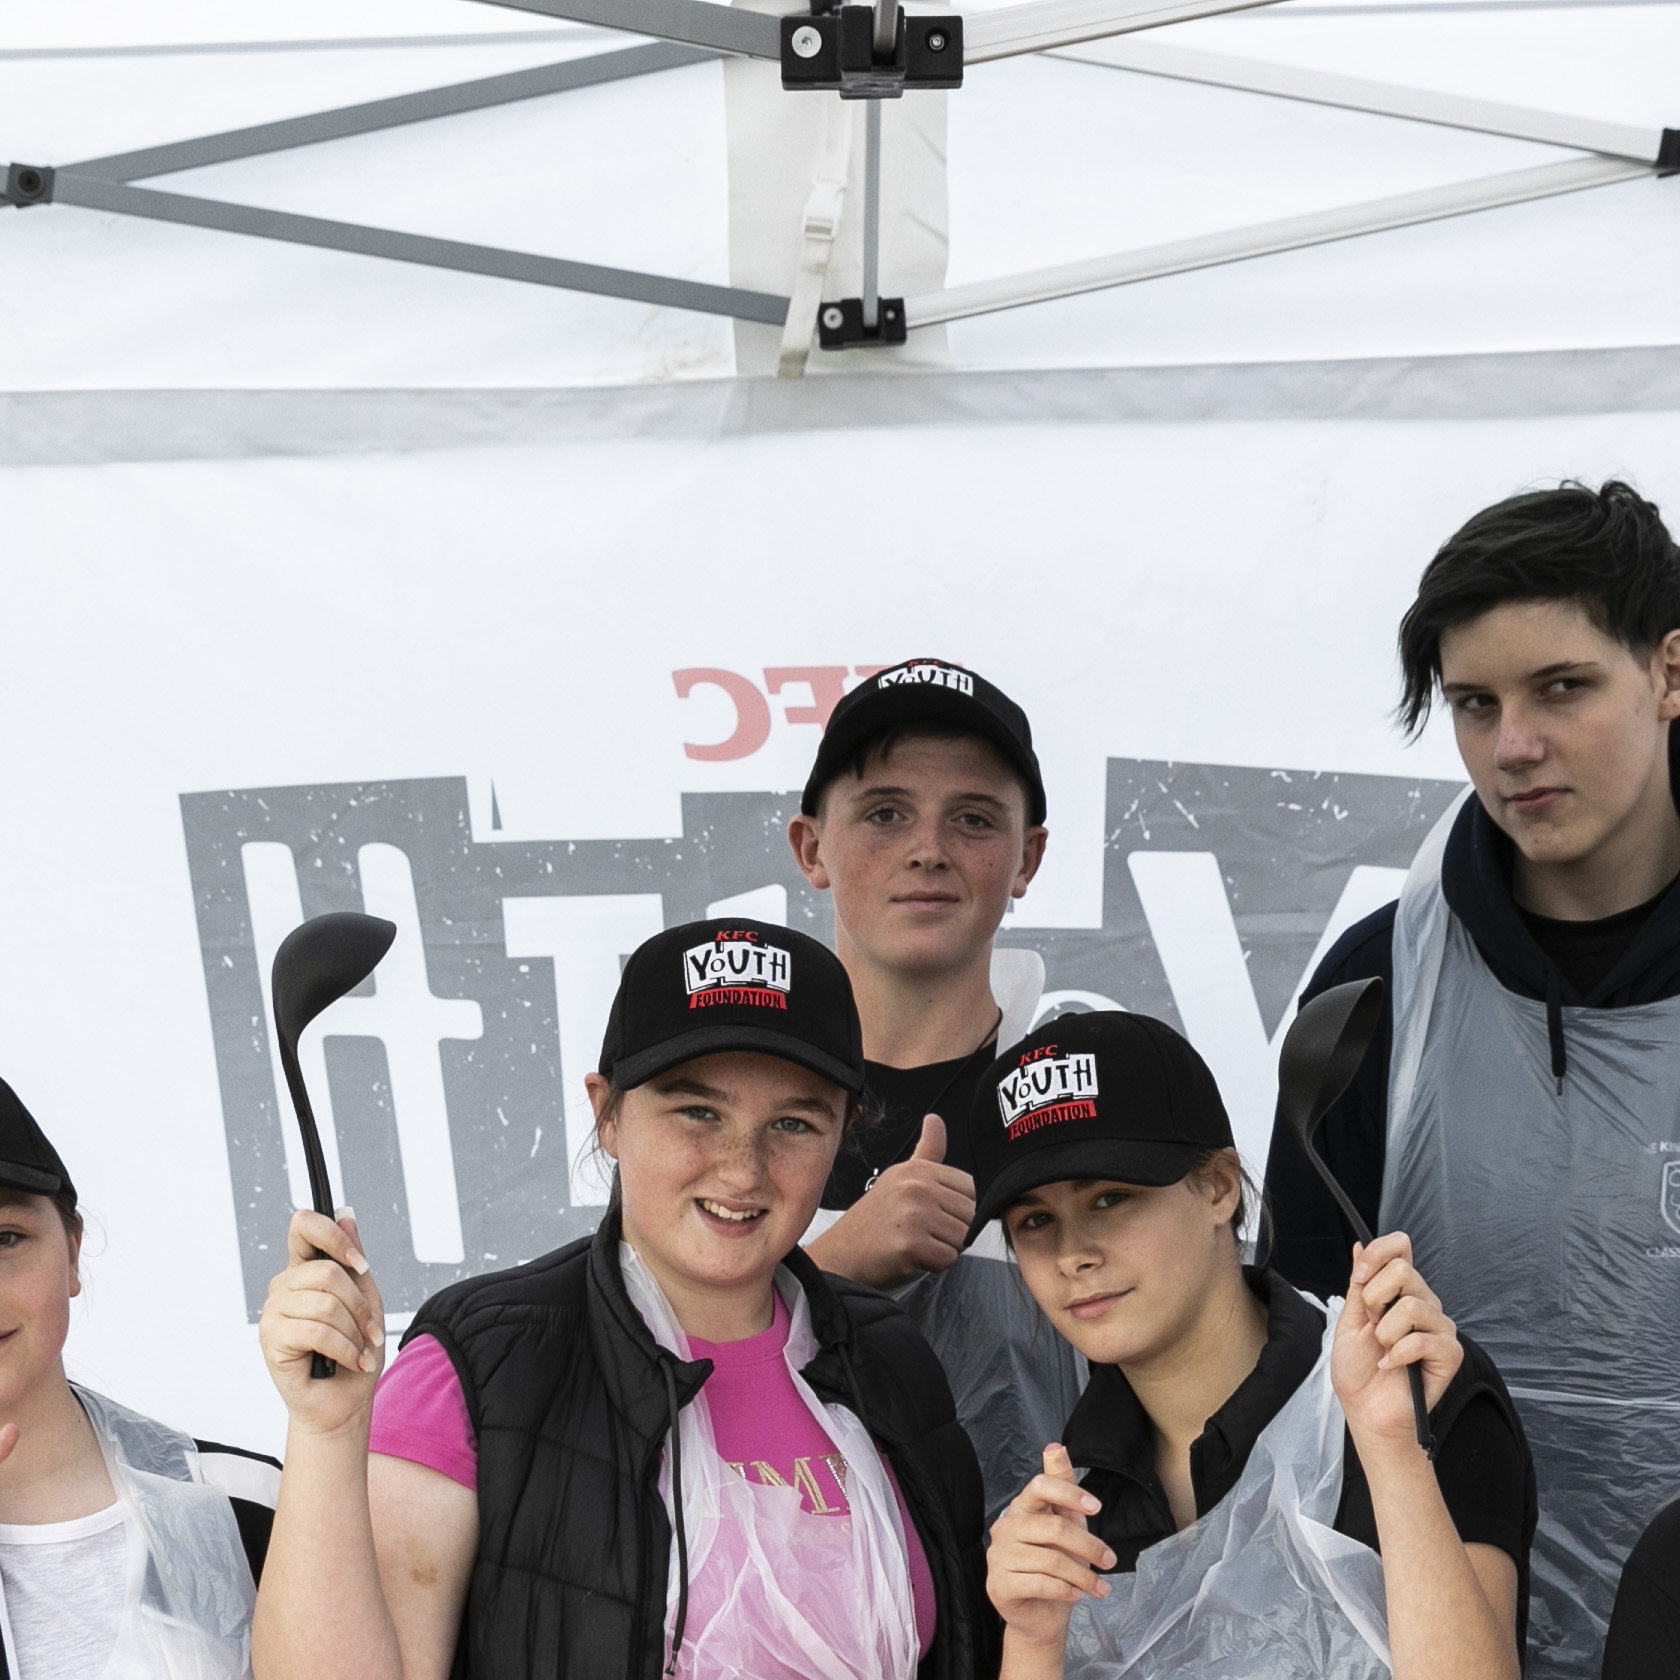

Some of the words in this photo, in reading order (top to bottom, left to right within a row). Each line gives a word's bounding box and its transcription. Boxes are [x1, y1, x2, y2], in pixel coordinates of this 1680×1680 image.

[715, 930, 758, 942] KFC
[690, 949, 786, 982] YOUTH
[696, 989, 781, 1008] FOUNDATION
[1019, 1044, 1058, 1067] KFC
[1002, 1058, 1093, 1111] YOUTH
[1010, 1103, 1091, 1141] FOUNDATION
